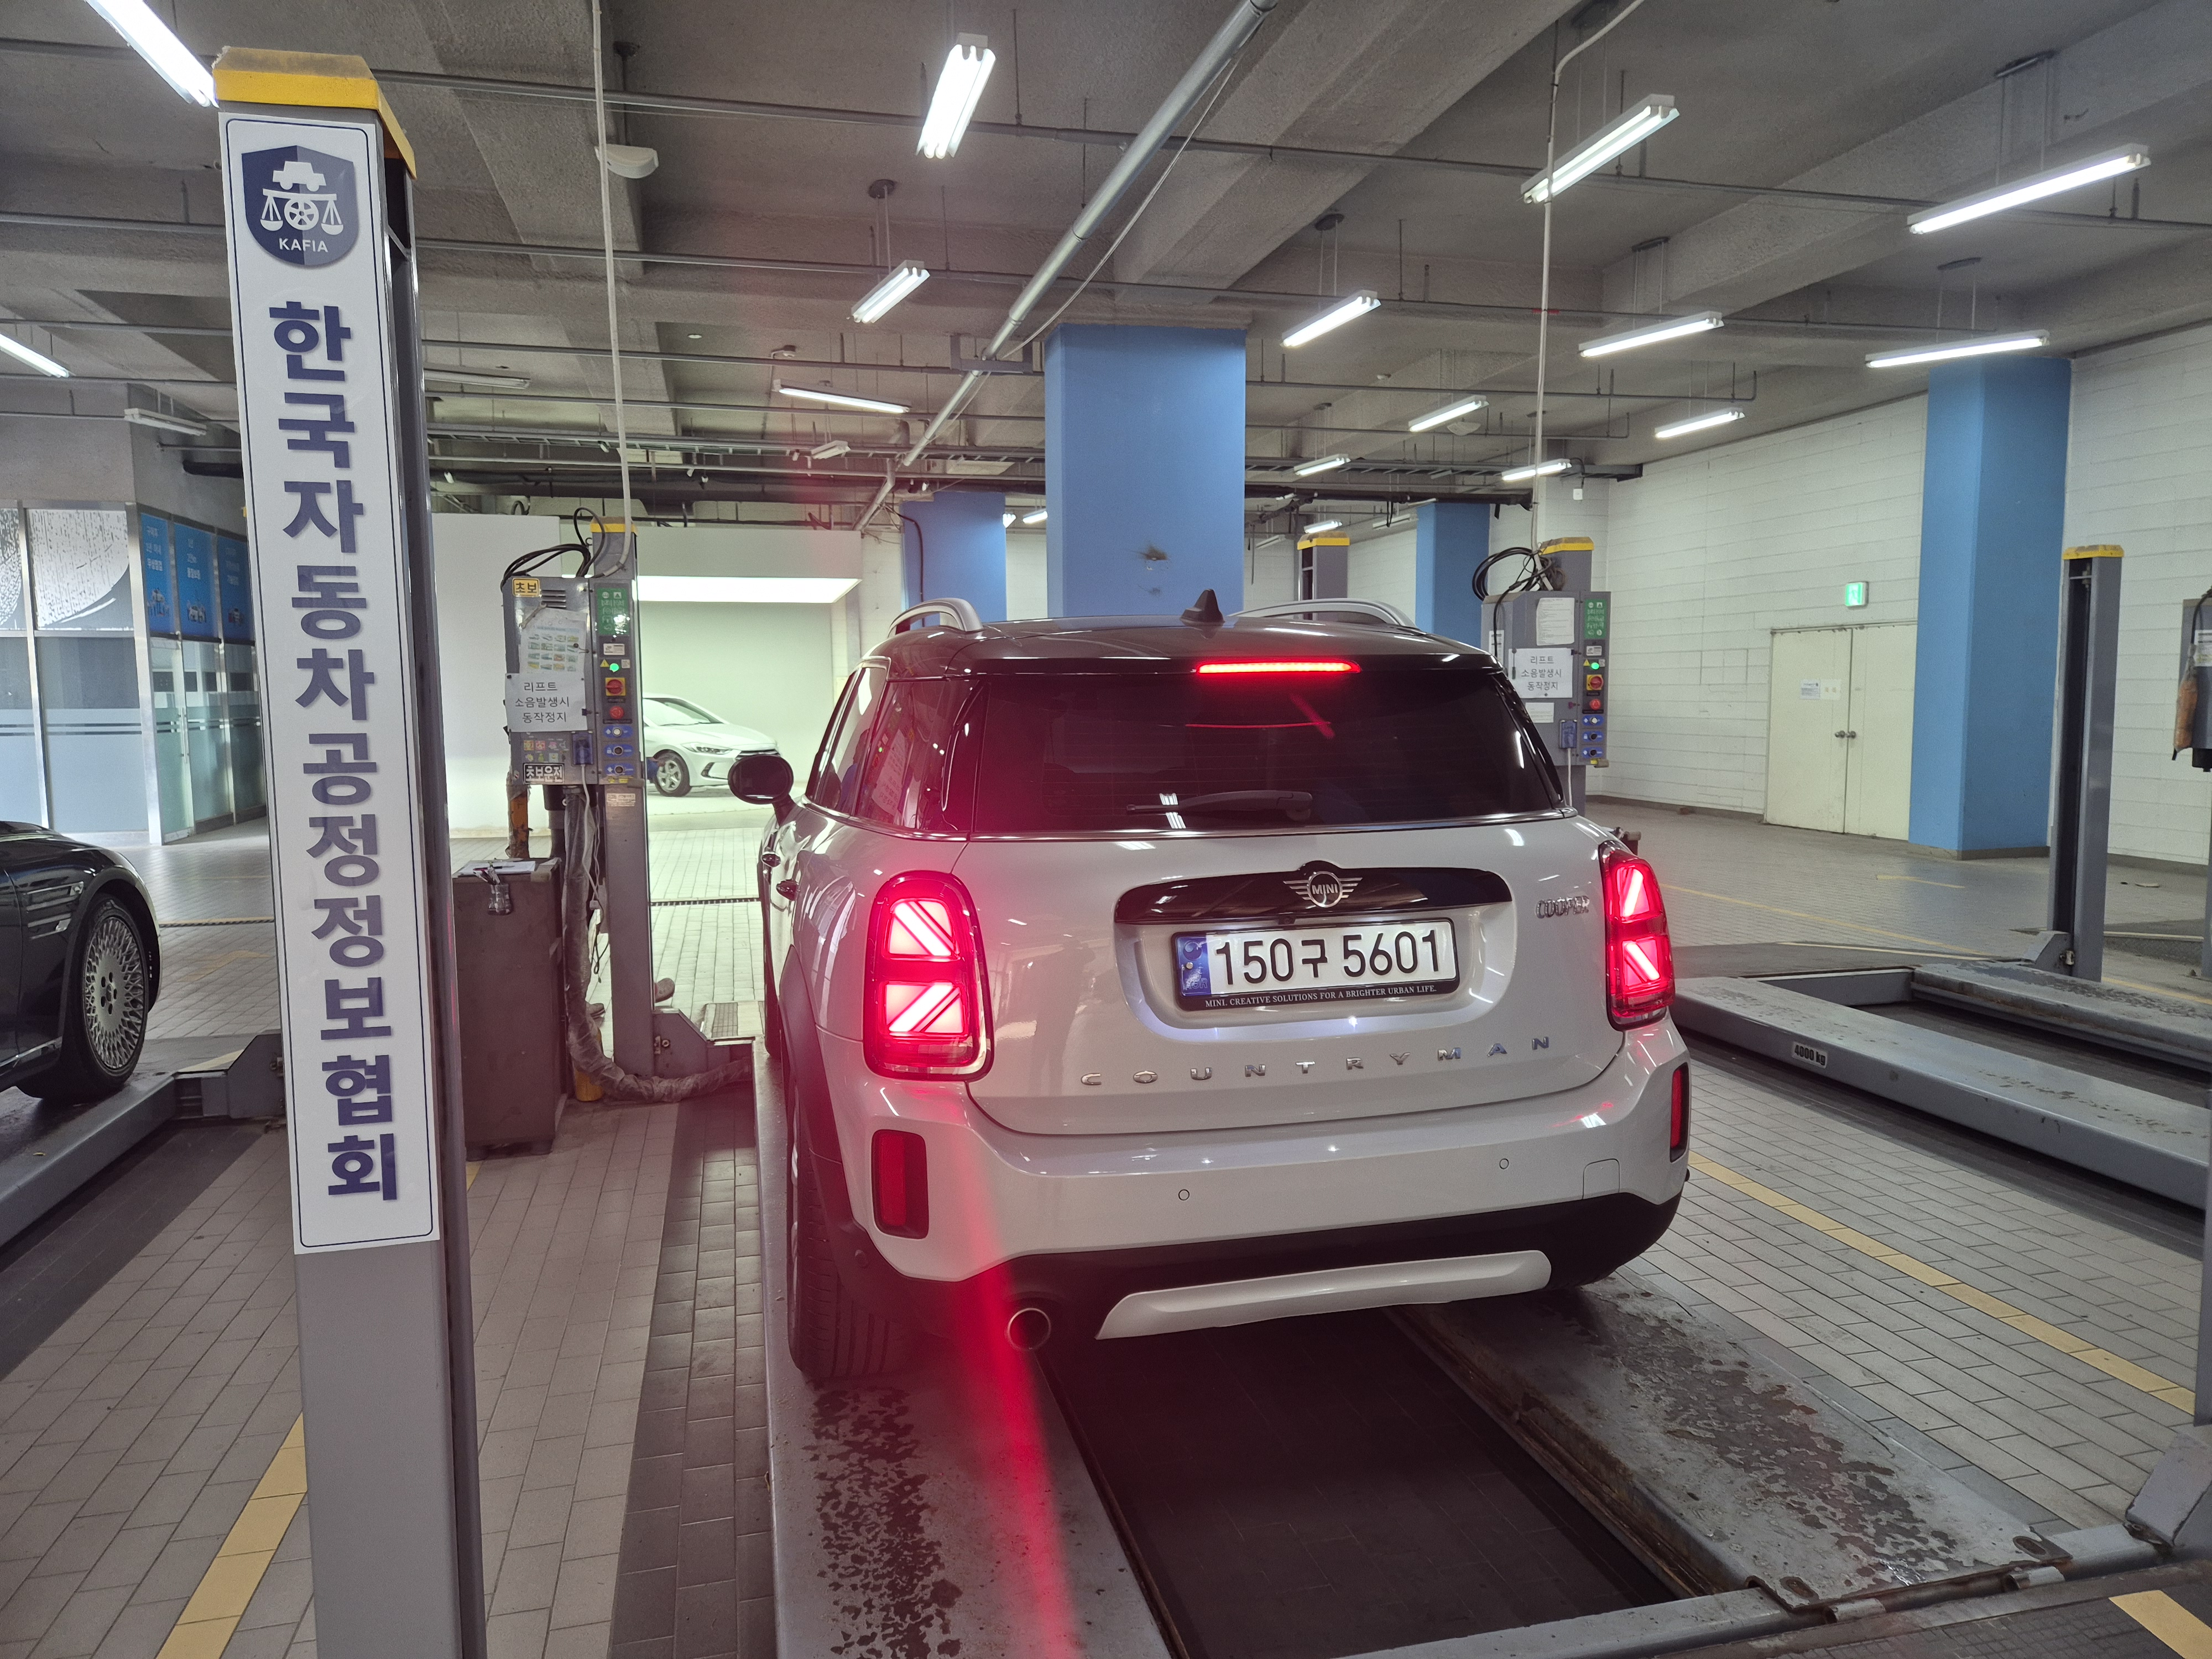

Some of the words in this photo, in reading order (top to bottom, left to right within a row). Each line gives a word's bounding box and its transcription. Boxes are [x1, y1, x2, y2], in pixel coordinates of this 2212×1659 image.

[279, 238, 328, 253] KAFIA
[515, 582, 537, 594] 초보
[1530, 656, 1554, 665] 리프트
[1521, 669, 1562, 678] 소음발생시
[524, 682, 558, 692] 리프트
[1527, 682, 1558, 691] 동작정지
[515, 696, 570, 707] 소음발생시
[522, 712, 567, 723] 동작정지
[269, 301, 398, 1202] 한국자동차공정정보협회
[525, 766, 563, 782] 초보운전
[1312, 884, 1338, 894] MINI
[1205, 999, 1227, 1008] MINI.
[1230, 996, 1270, 1005] CREATIVE
[1272, 993, 1317, 1003] SOLUTIONS
[1346, 988, 1386, 998] BRIGHTER
[1388, 986, 1415, 995] URBAN
[1417, 985, 1437, 993] LIFE.
[1081, 1036, 1549, 1086] COUNTRYMAN
[1794, 1045, 1814, 1061] 4000
[1816, 1051, 1825, 1066] kg
